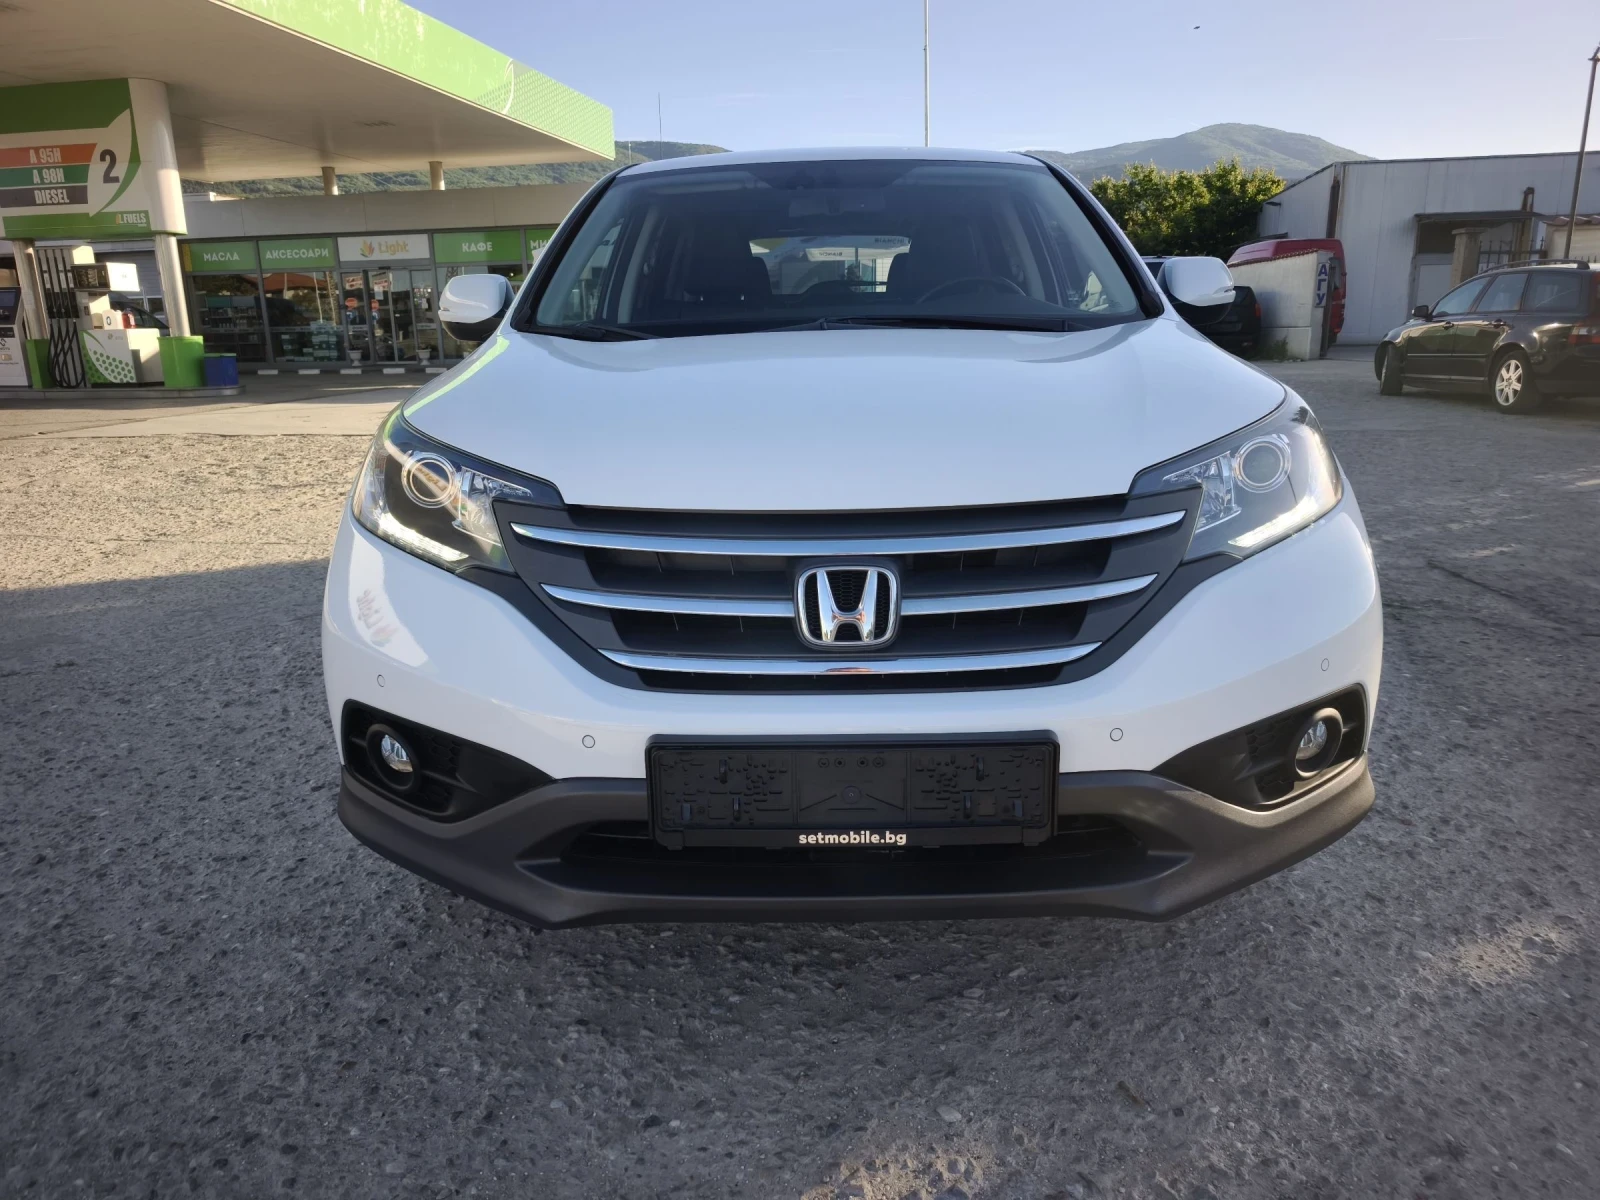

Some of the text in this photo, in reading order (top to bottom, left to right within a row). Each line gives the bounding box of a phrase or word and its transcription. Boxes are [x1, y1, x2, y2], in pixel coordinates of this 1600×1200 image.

[30, 149, 37, 164] A
[99, 148, 120, 184] 2
[33, 169, 40, 184] A
[34, 189, 69, 204] DIESEL
[377, 240, 409, 255] Light
[462, 241, 493, 253] КАФЕ
[530, 239, 551, 250] МИ
[203, 251, 240, 262] МАСЛА
[265, 248, 329, 260] АКСЕСОАРИ
[798, 830, 907, 846] setmobile.bg
